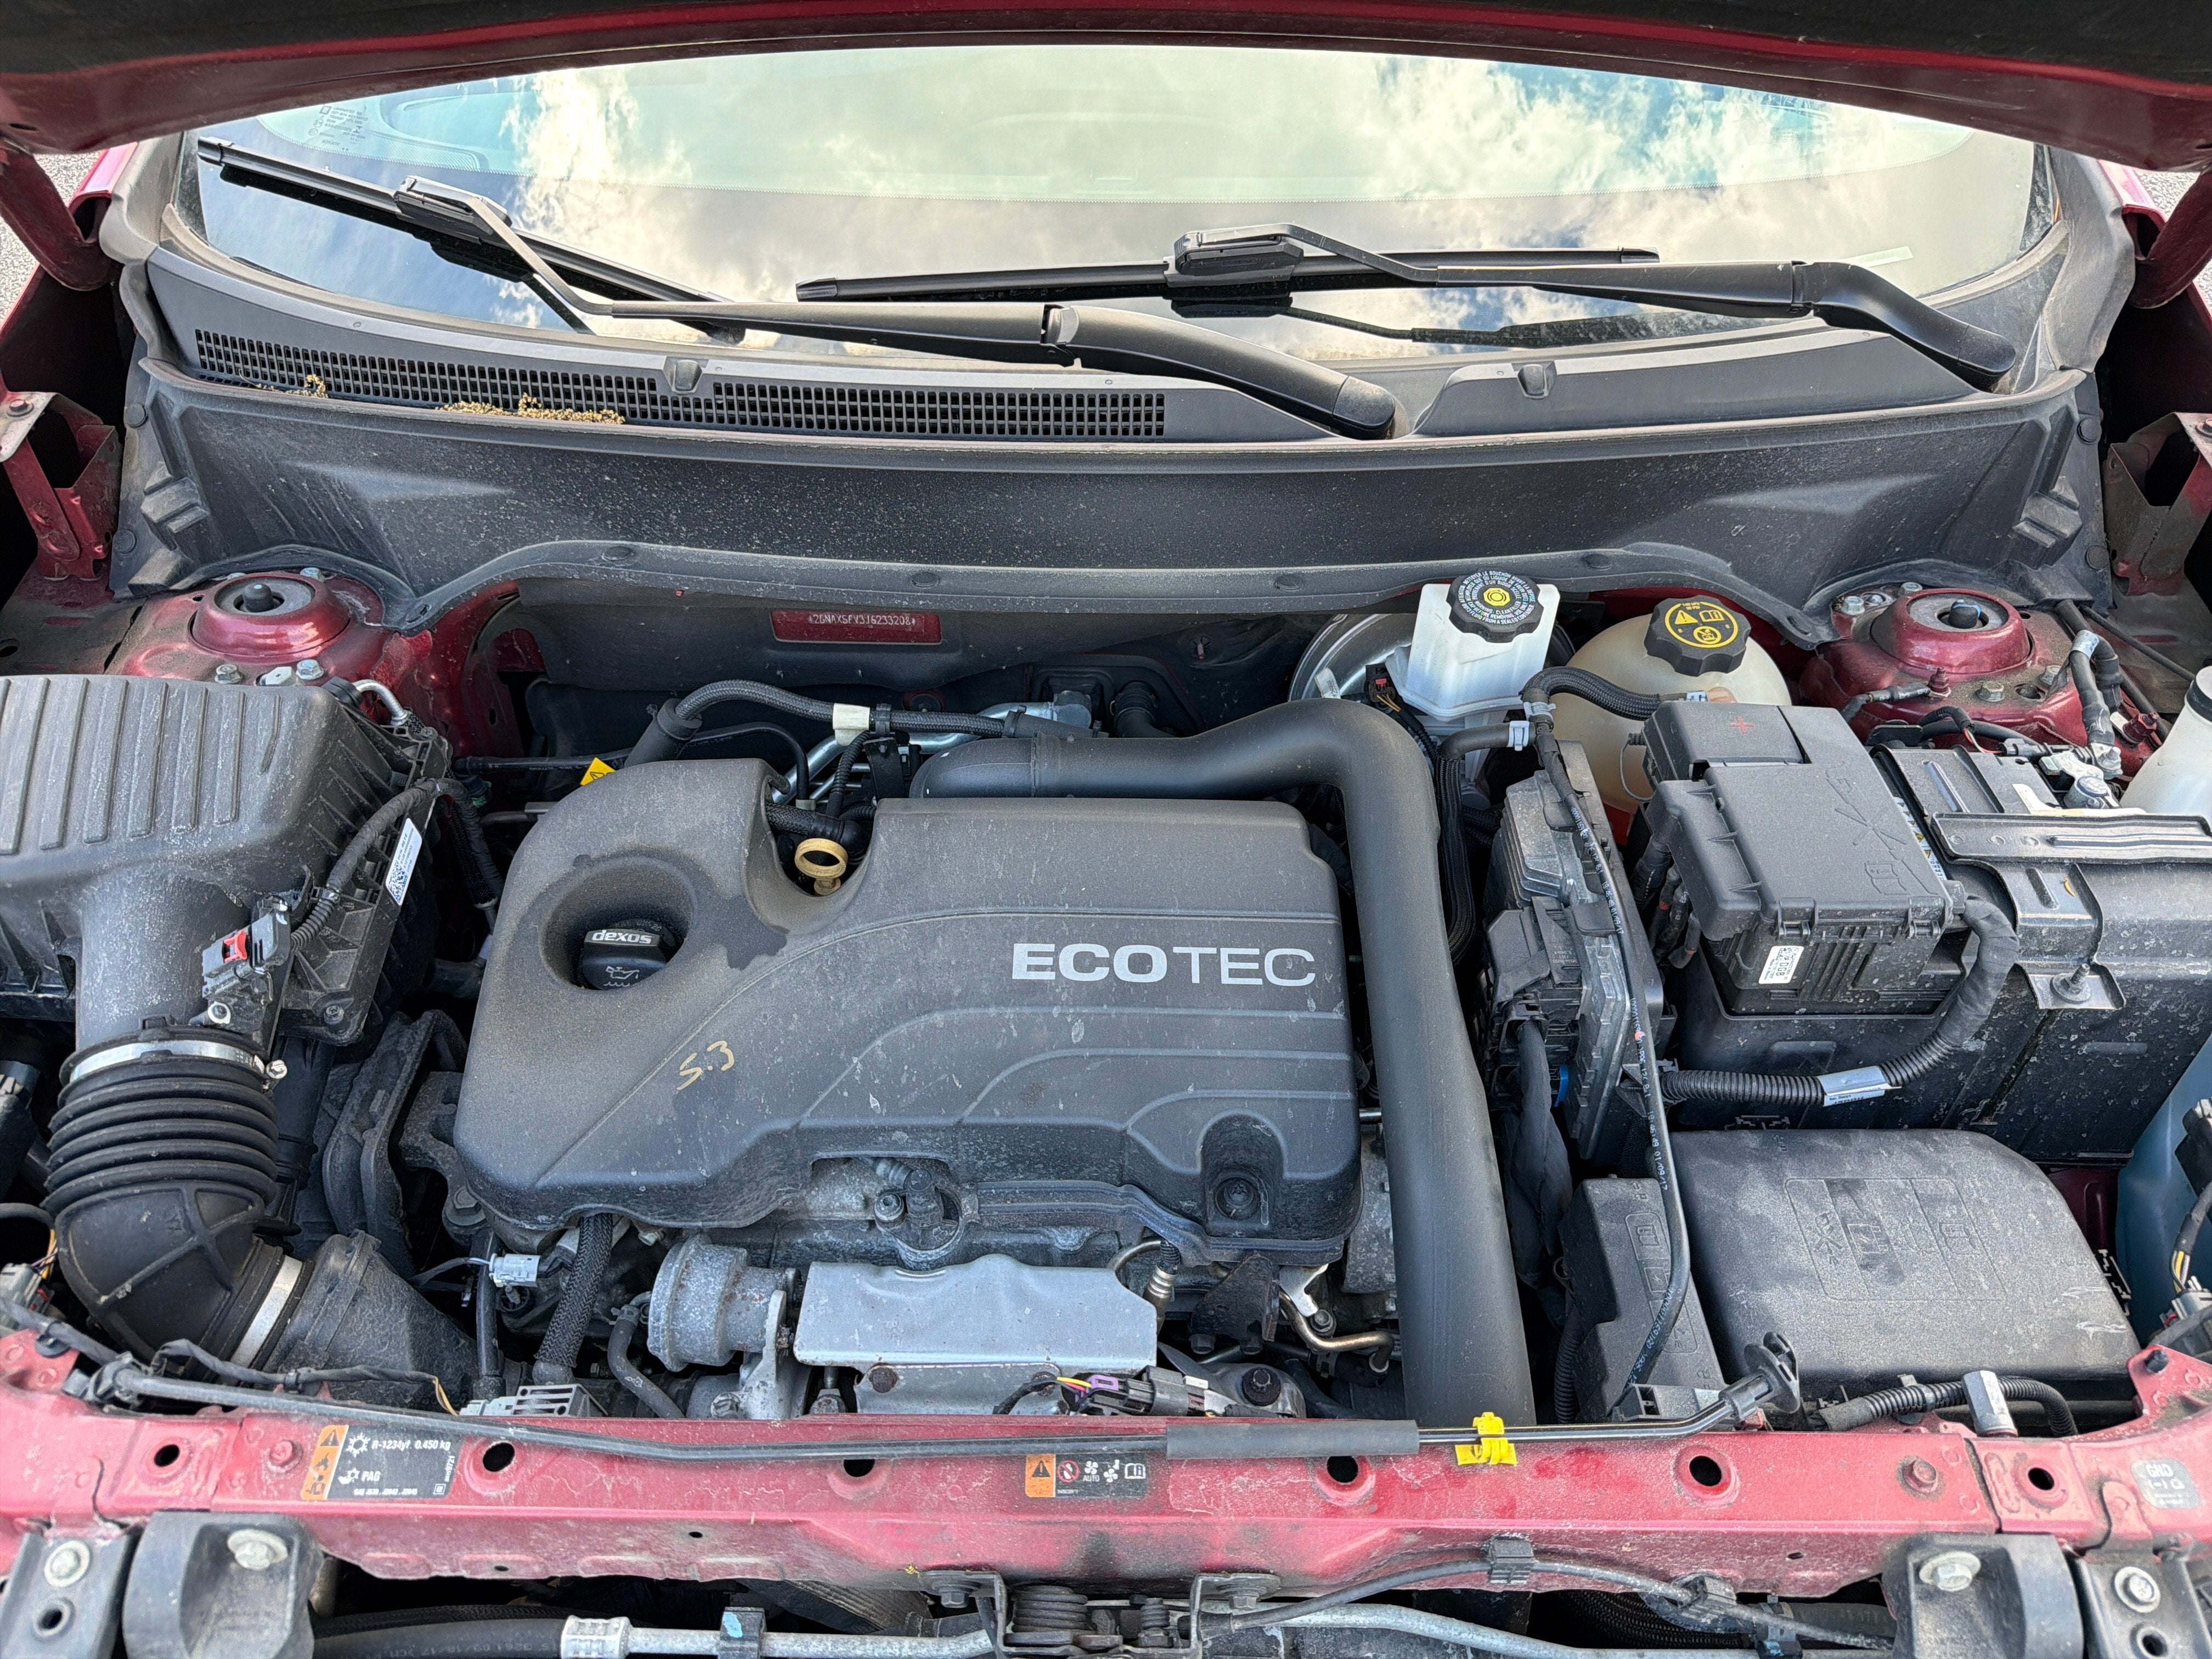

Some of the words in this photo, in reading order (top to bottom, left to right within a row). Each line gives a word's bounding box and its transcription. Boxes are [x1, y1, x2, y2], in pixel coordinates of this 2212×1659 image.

[592, 930, 653, 944] dexos
[1012, 943, 1317, 986] ECOTEC
[415, 1440, 438, 1449] 0.450
[440, 1441, 451, 1451] kg
[362, 1471, 381, 1481] PAG
